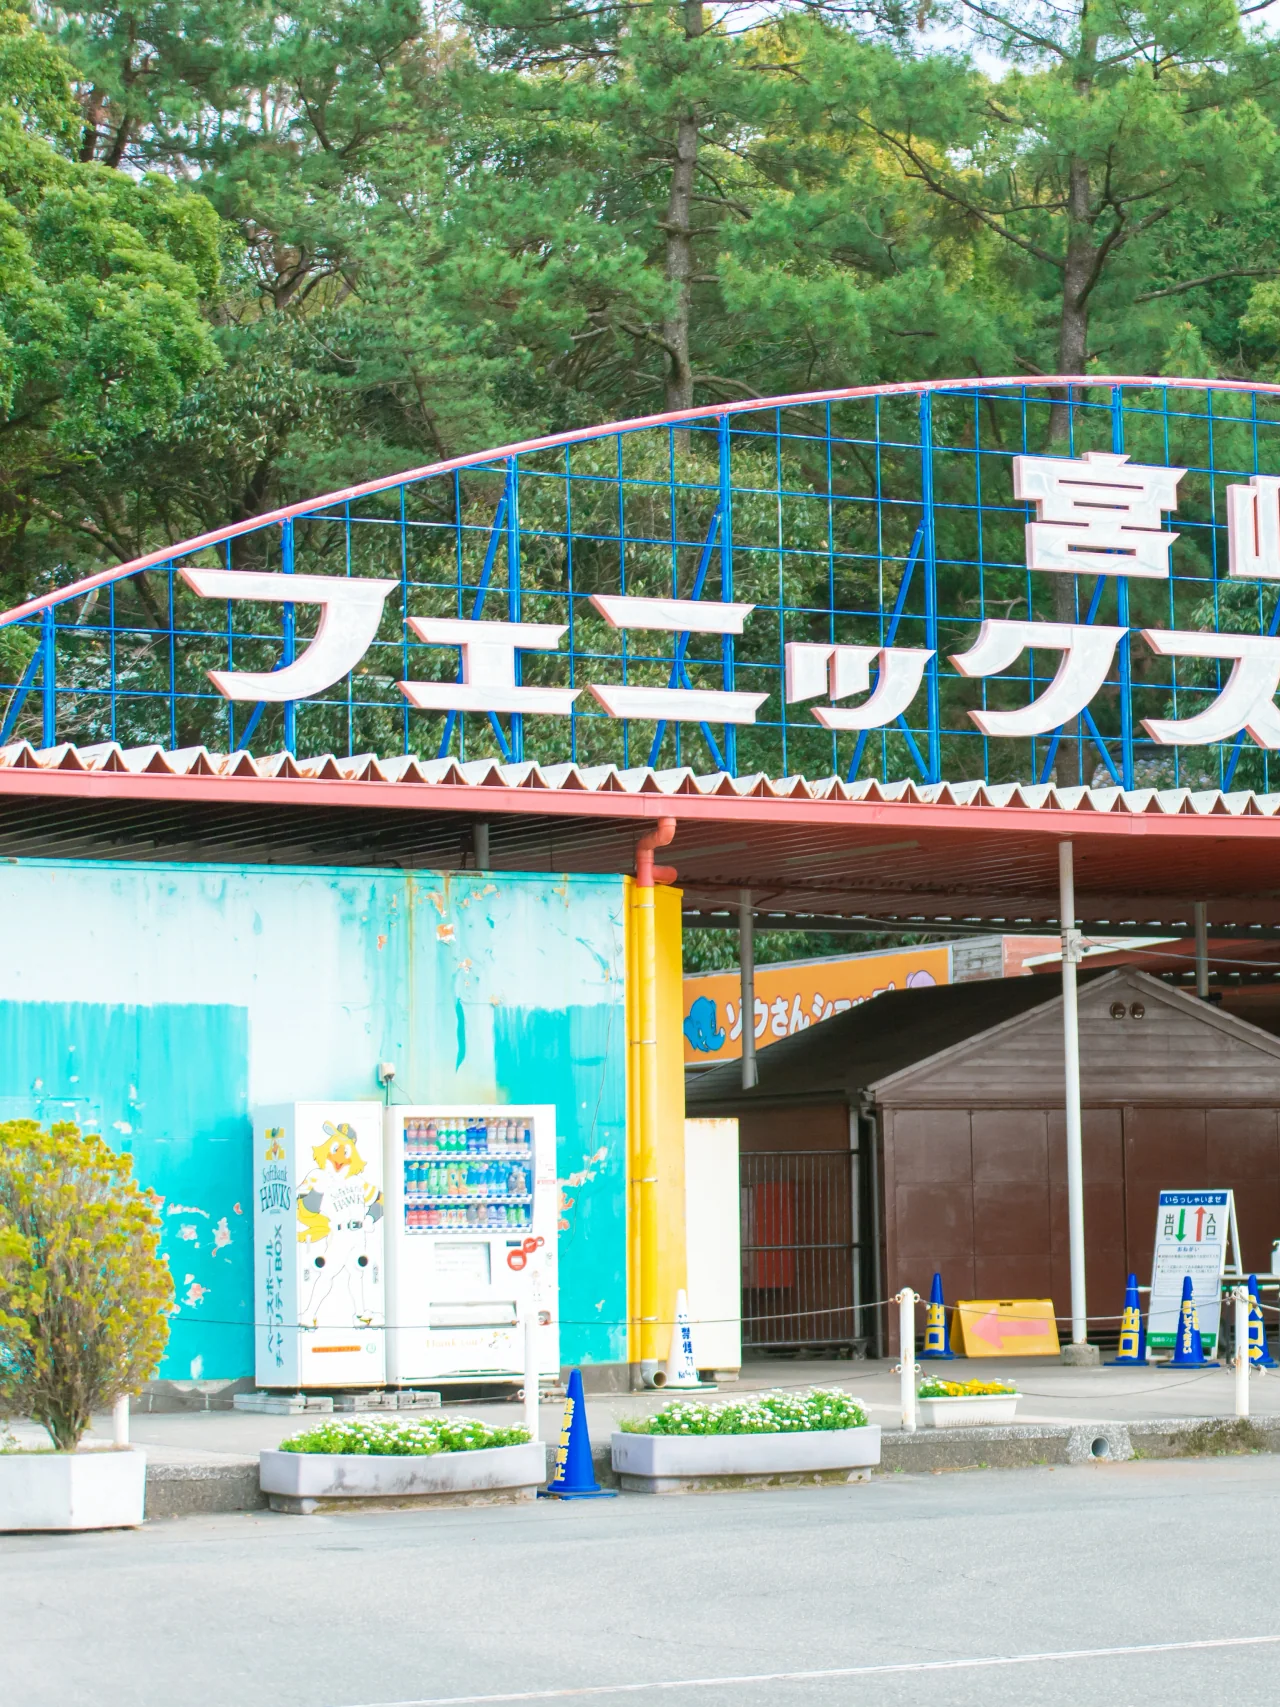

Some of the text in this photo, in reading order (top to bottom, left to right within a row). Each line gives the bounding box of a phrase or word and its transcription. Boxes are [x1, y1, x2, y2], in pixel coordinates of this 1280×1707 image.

[260, 1183, 291, 1212] HAWKS
[1165, 1195, 1222, 1204] いらっしゃいませ
[1164, 1213, 1175, 1235] 出口
[1206, 1213, 1217, 1235] 入口
[265, 1239, 274, 1353] ベースボール
[925, 1303, 945, 1350] 出口
[1118, 1307, 1140, 1358] 出口
